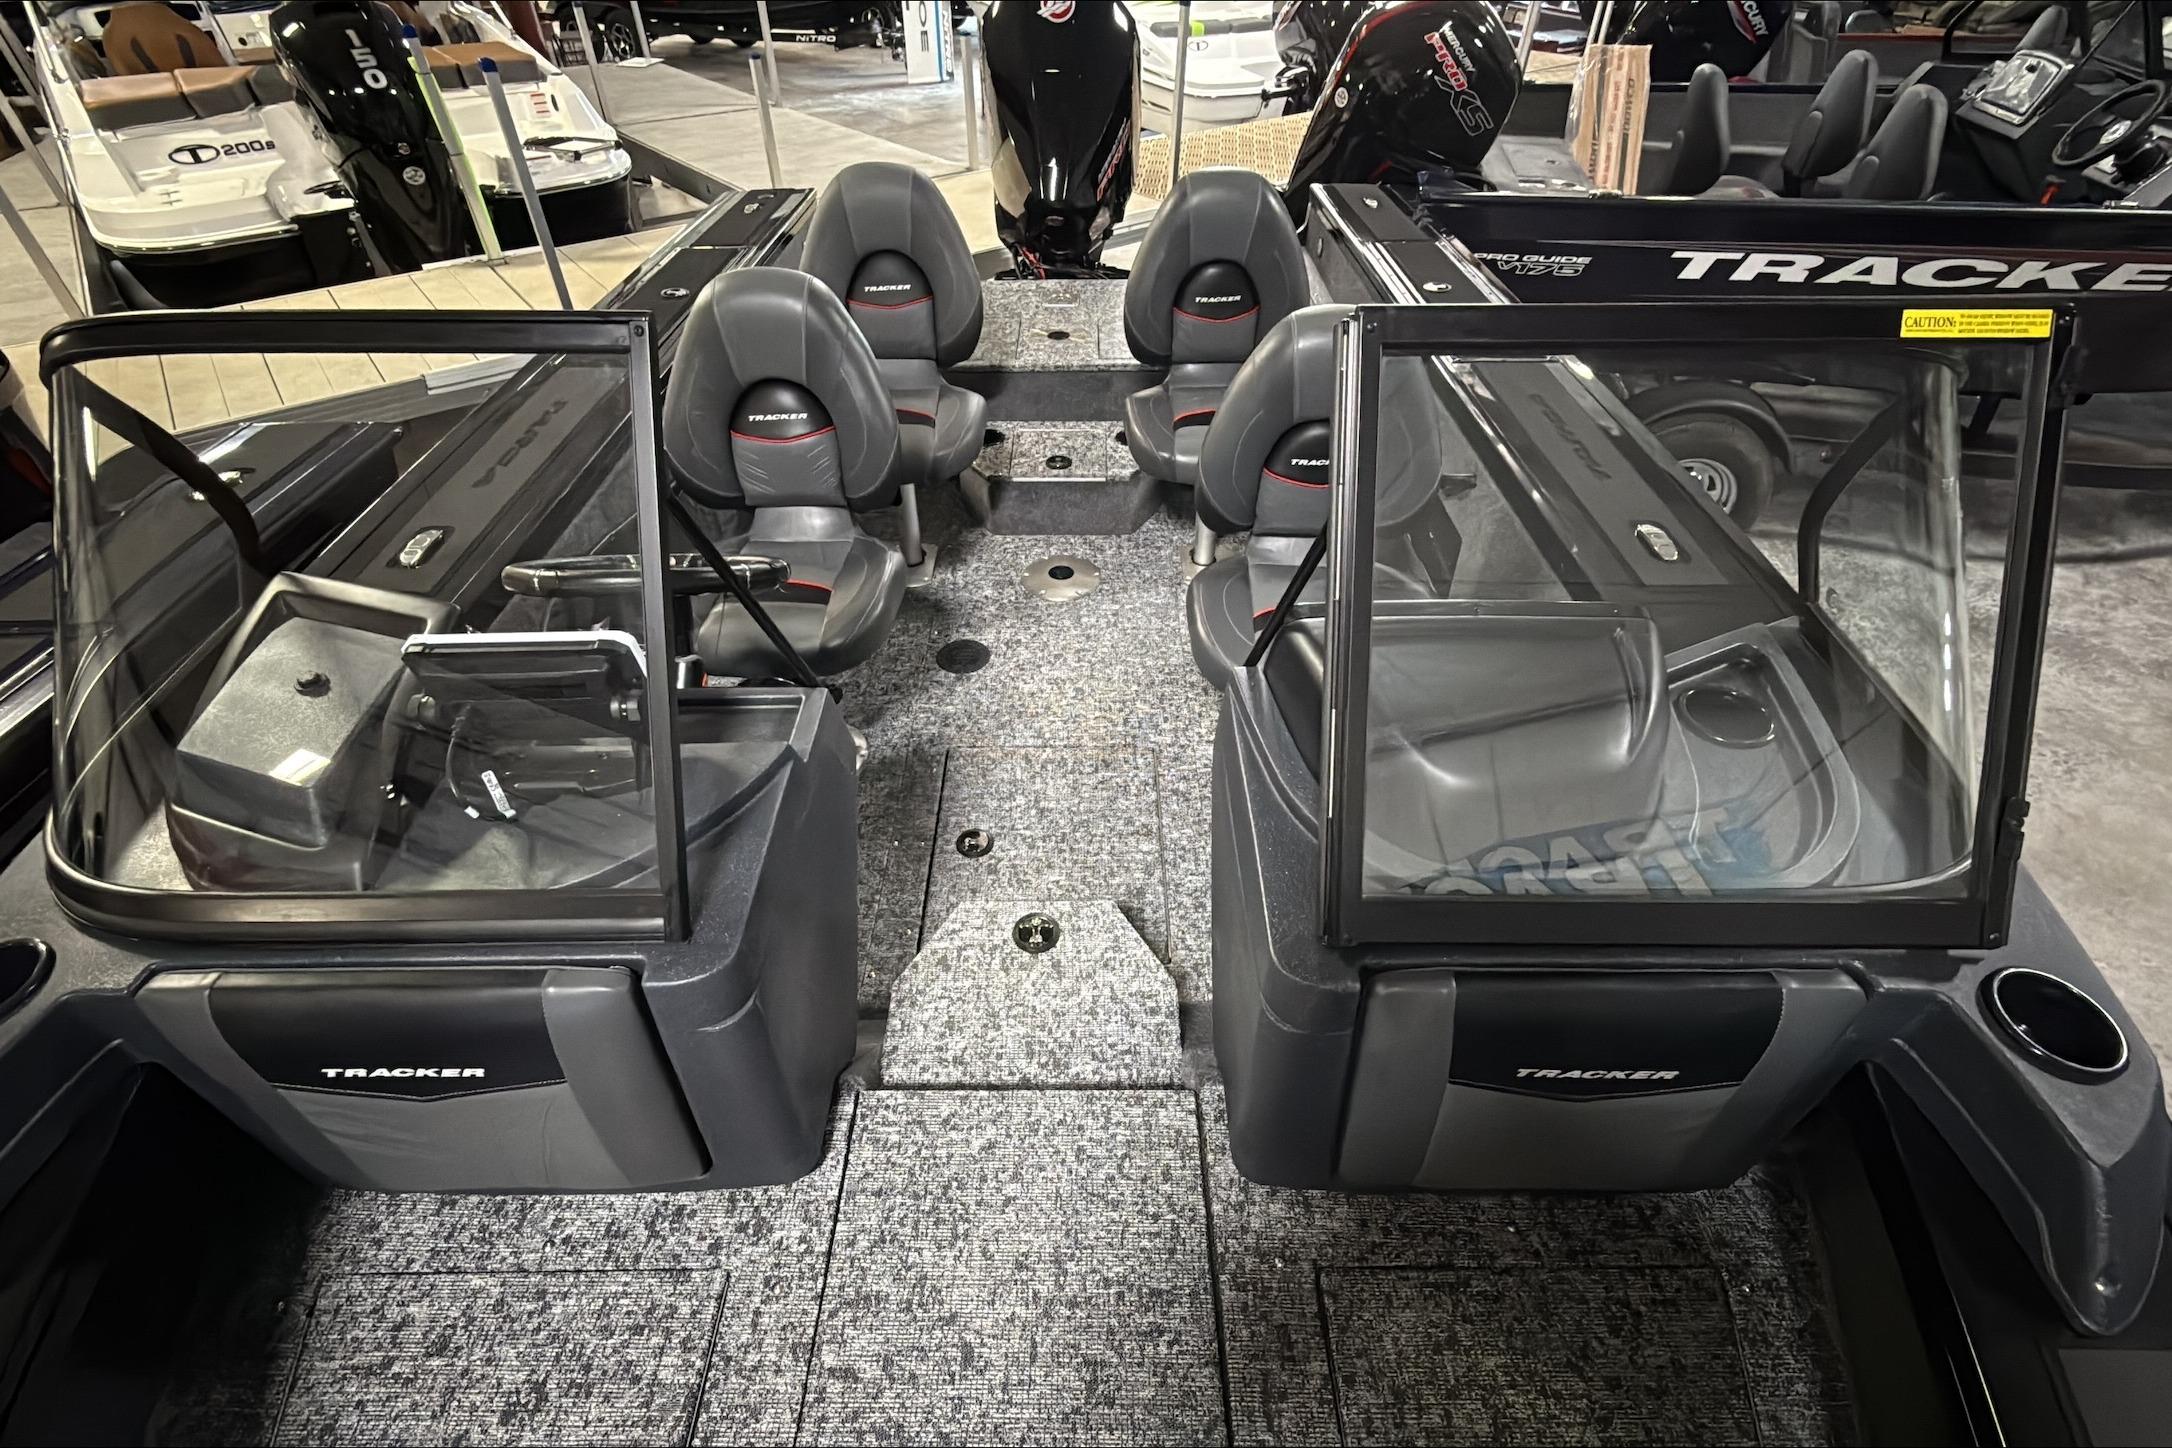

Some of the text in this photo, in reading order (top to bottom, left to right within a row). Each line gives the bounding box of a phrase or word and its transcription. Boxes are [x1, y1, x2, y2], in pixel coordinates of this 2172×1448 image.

[1741, 1, 1769, 35] CURY
[1438, 21, 1477, 72] MERCURY
[345, 28, 389, 89] 150
[1473, 252, 1593, 265] PRO GUIDE
[1670, 250, 2172, 292] TRACKE
[863, 284, 912, 293] TRACKER
[1194, 294, 1242, 303] TRACKER
[1904, 316, 1957, 328] CAUTION:
[747, 412, 809, 422] TRACKER
[320, 1067, 486, 1079] TRACKER
[1515, 1068, 1680, 1080] TRACKER
